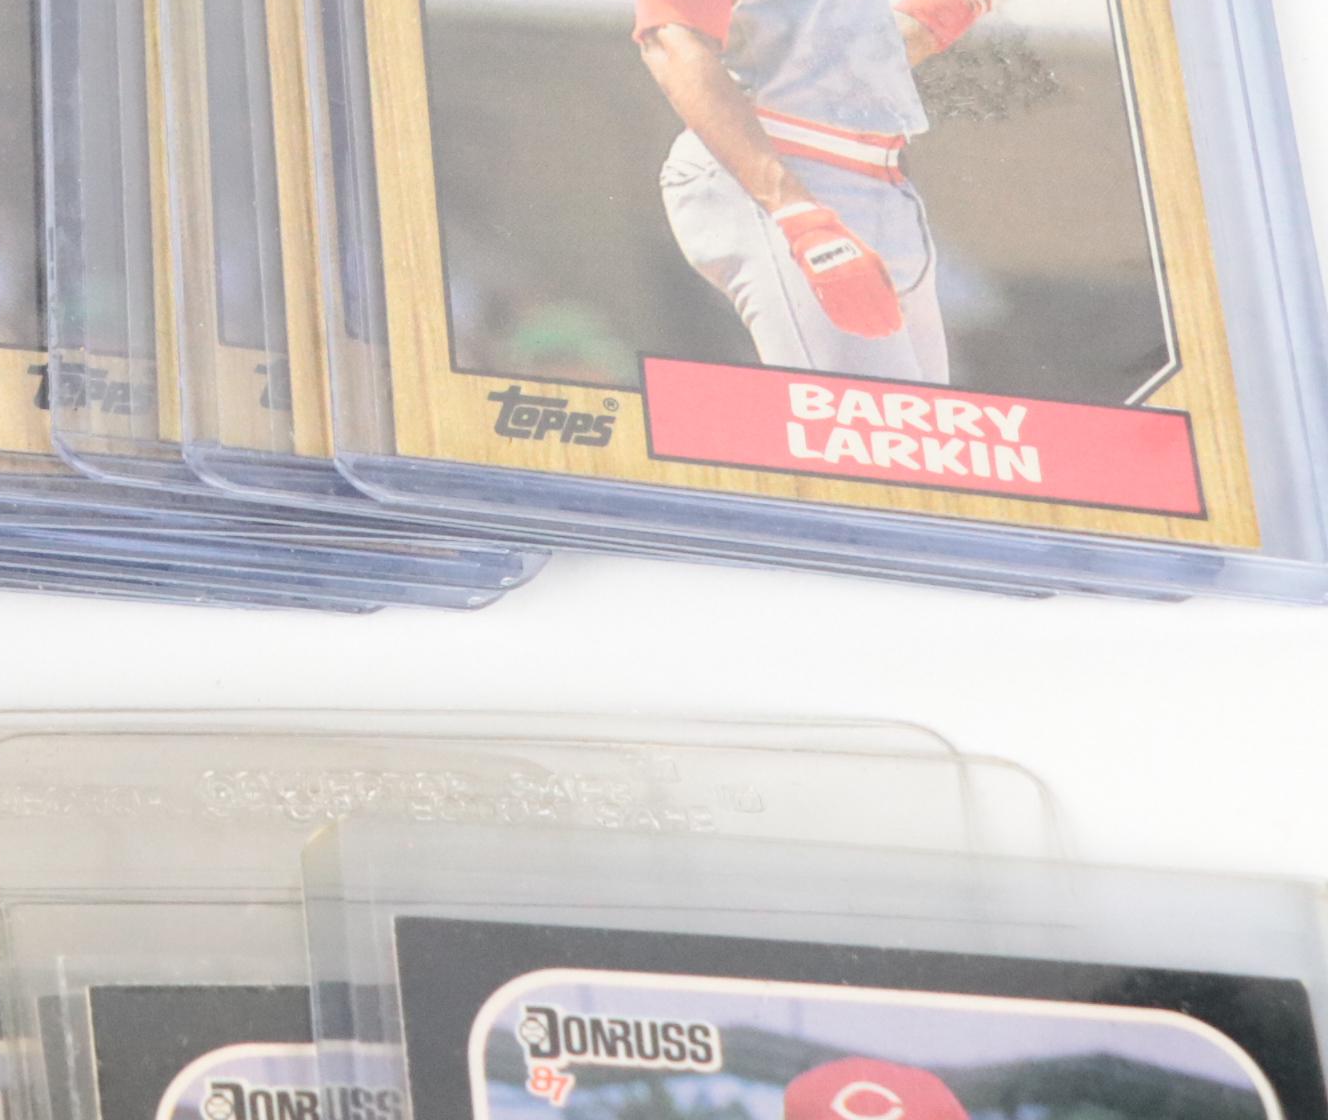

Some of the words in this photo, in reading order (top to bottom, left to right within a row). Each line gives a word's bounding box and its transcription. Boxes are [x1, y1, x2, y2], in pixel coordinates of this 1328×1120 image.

[788, 383, 1028, 441] BARRY
[786, 422, 1043, 483] LARKIN
[519, 1004, 714, 1064] DONRUSS
[530, 1066, 570, 1102] 87
